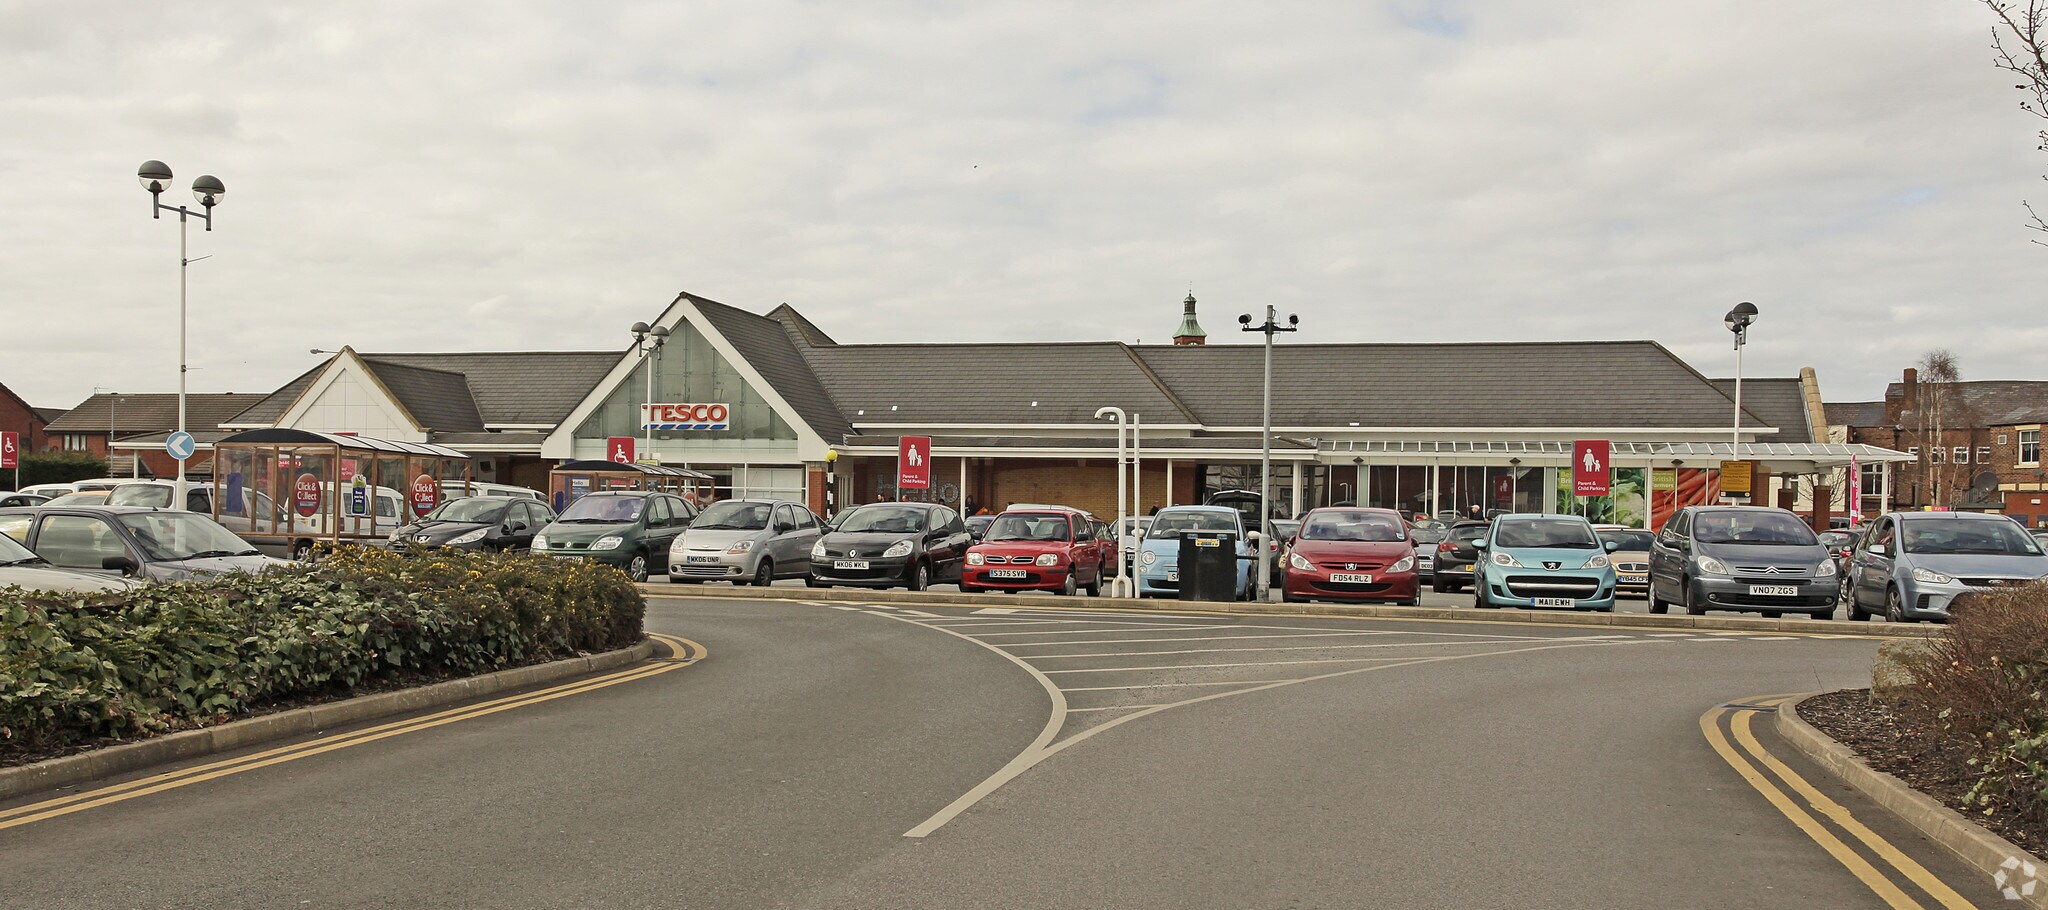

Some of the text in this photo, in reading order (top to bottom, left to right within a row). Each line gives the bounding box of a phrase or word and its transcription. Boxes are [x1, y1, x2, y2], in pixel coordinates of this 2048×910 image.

[642, 405, 727, 422] TESCO
[1753, 586, 1794, 595] VN07 ZGS
